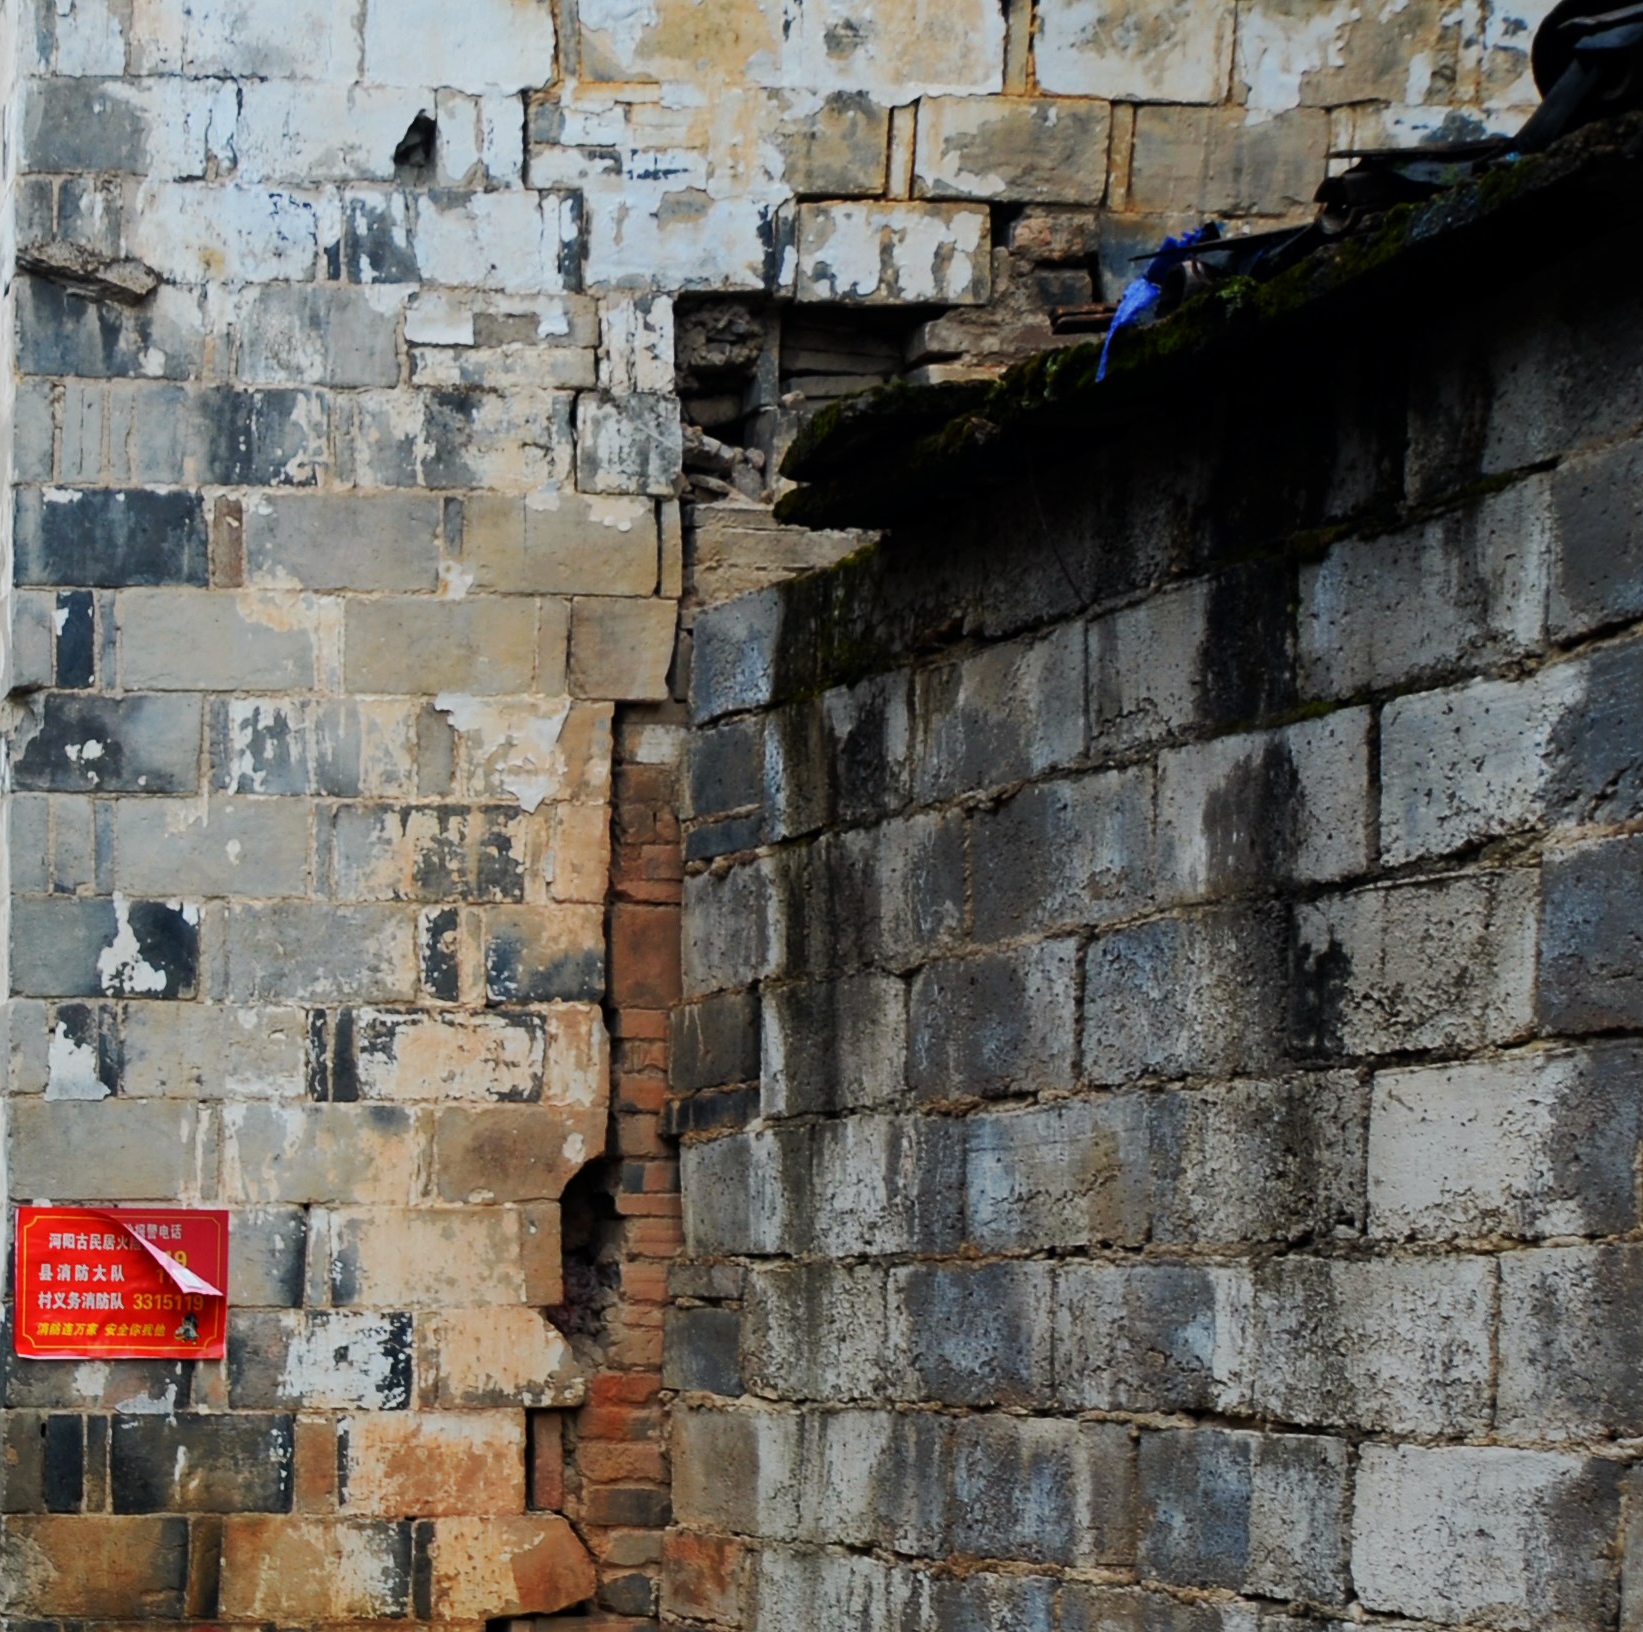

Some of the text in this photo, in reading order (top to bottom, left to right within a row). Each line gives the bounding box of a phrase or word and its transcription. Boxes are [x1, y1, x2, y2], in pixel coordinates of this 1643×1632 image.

[39, 1263, 124, 1282] 县消防大队
[38, 1292, 203, 1311] 村义务消防队 3315119
